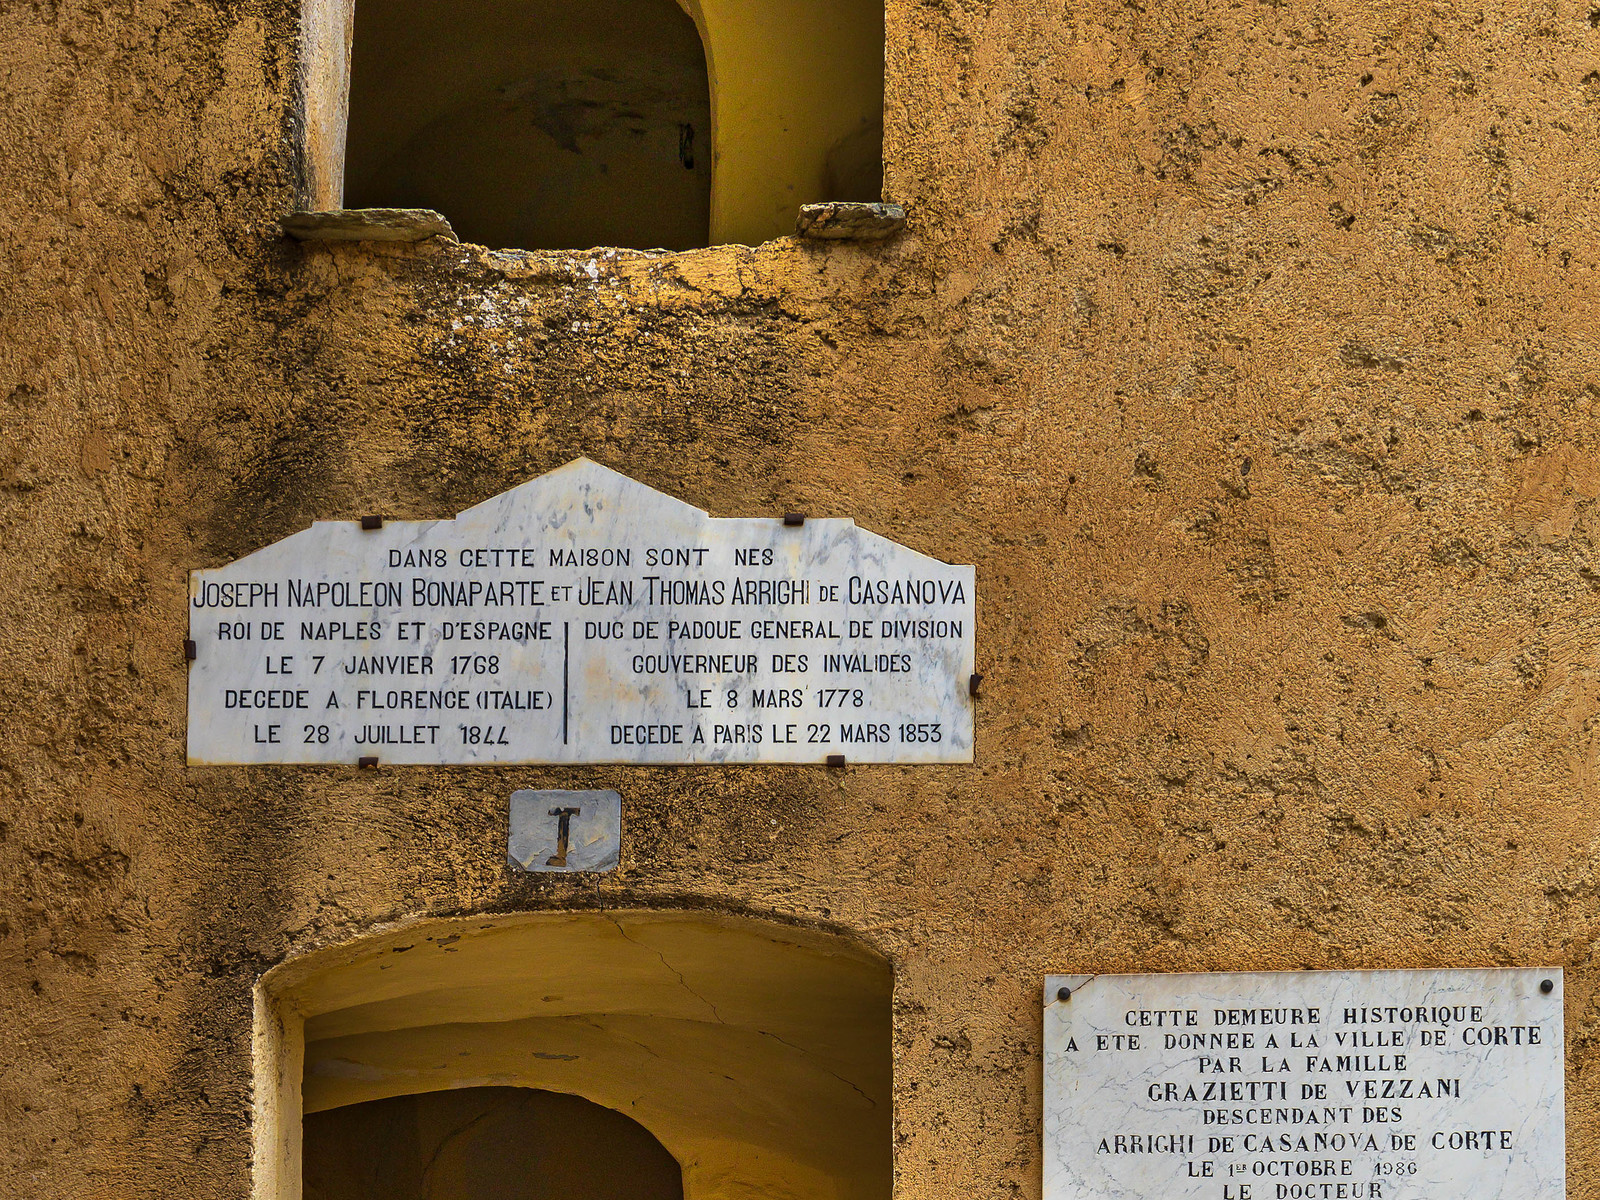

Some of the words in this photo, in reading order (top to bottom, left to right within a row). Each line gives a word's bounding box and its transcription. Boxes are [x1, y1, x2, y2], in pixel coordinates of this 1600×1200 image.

[459, 548, 535, 568] CETTE
[645, 548, 710, 567] SONT
[192, 580, 278, 609] JOSEPH
[287, 578, 402, 608] NAPOLEON
[412, 577, 545, 607] BONAPARTE
[550, 586, 573, 602] ET
[578, 576, 633, 606] JEAN
[642, 576, 725, 606] THOMAS
[731, 576, 809, 606] ARRIGHI
[819, 585, 839, 602] DE
[848, 575, 966, 605] CASANOVA
[218, 621, 251, 641] ROI
[260, 621, 285, 641] DE
[300, 621, 382, 641] NAPLES
[397, 621, 426, 641] ET
[442, 621, 552, 641] D'ESPAGNE
[585, 621, 624, 640] DUC
[632, 621, 659, 640] DE
[668, 620, 742, 640] PADOUE
[750, 620, 841, 639] GENERAL
[849, 620, 874, 639] DE
[881, 620, 962, 639] DIVISION
[266, 655, 294, 675] LE
[312, 655, 326, 675] 7
[344, 655, 433, 675] JANVIER
[450, 655, 500, 675] 1768
[632, 654, 758, 674] GOUVERNEUR
[772, 654, 809, 673] DES
[824, 654, 912, 673] INVALIDES
[224, 689, 309, 709] DECEDE
[325, 690, 340, 709] A
[357, 690, 470, 710] FLORENCE
[476, 690, 553, 710] (ITALIE)
[686, 689, 712, 709] LE
[726, 689, 738, 709] 8
[752, 688, 803, 708] MARS
[817, 689, 864, 708] 1778
[254, 724, 281, 744] LE
[303, 724, 330, 744] 28
[354, 724, 440, 745] JUILLET
[460, 725, 509, 746] 1844
[610, 724, 684, 745] DECEDE
[692, 724, 705, 744] A
[714, 724, 763, 744] PARIS
[772, 724, 798, 744] LE
[807, 723, 831, 743] 22
[840, 723, 891, 743] MARS
[898, 723, 942, 743] 1853
[1125, 1009, 1198, 1027] CETTE
[1213, 1008, 1320, 1026] DEMEURE
[1343, 1005, 1483, 1027] HISTORIQUE
[1064, 1036, 1080, 1053] A
[1096, 1034, 1140, 1051] ETE
[1164, 1032, 1255, 1050] DONNEE
[1264, 1033, 1279, 1049] A
[1290, 1032, 1319, 1048] LA
[1334, 1031, 1404, 1048] VILLE
[1420, 1030, 1446, 1047] DE
[1462, 1026, 1541, 1046] CORTE
[1199, 1056, 1242, 1074] PAR
[1261, 1056, 1291, 1073] LA
[1306, 1054, 1407, 1073] FAMILLE
[1148, 1081, 1287, 1102] GRAZIETTI
[1301, 1083, 1327, 1100] DE
[1345, 1078, 1460, 1100] VEZZANI
[1203, 1107, 1353, 1125] DESCENDANT
[1362, 1106, 1402, 1124] DES
[1096, 1134, 1194, 1155] ARRIGHI
[1208, 1137, 1235, 1154] DE
[1243, 1132, 1379, 1153] CASANOVA
[1391, 1134, 1416, 1151] DE
[1431, 1130, 1513, 1150] CORTE
[1187, 1160, 1214, 1178] LE
[1252, 1159, 1352, 1177] OCTOBRE
[1374, 1162, 1418, 1176] 1986
[1223, 1184, 1252, 1200] LE
[1275, 1182, 1382, 1200] DOCTEUR
